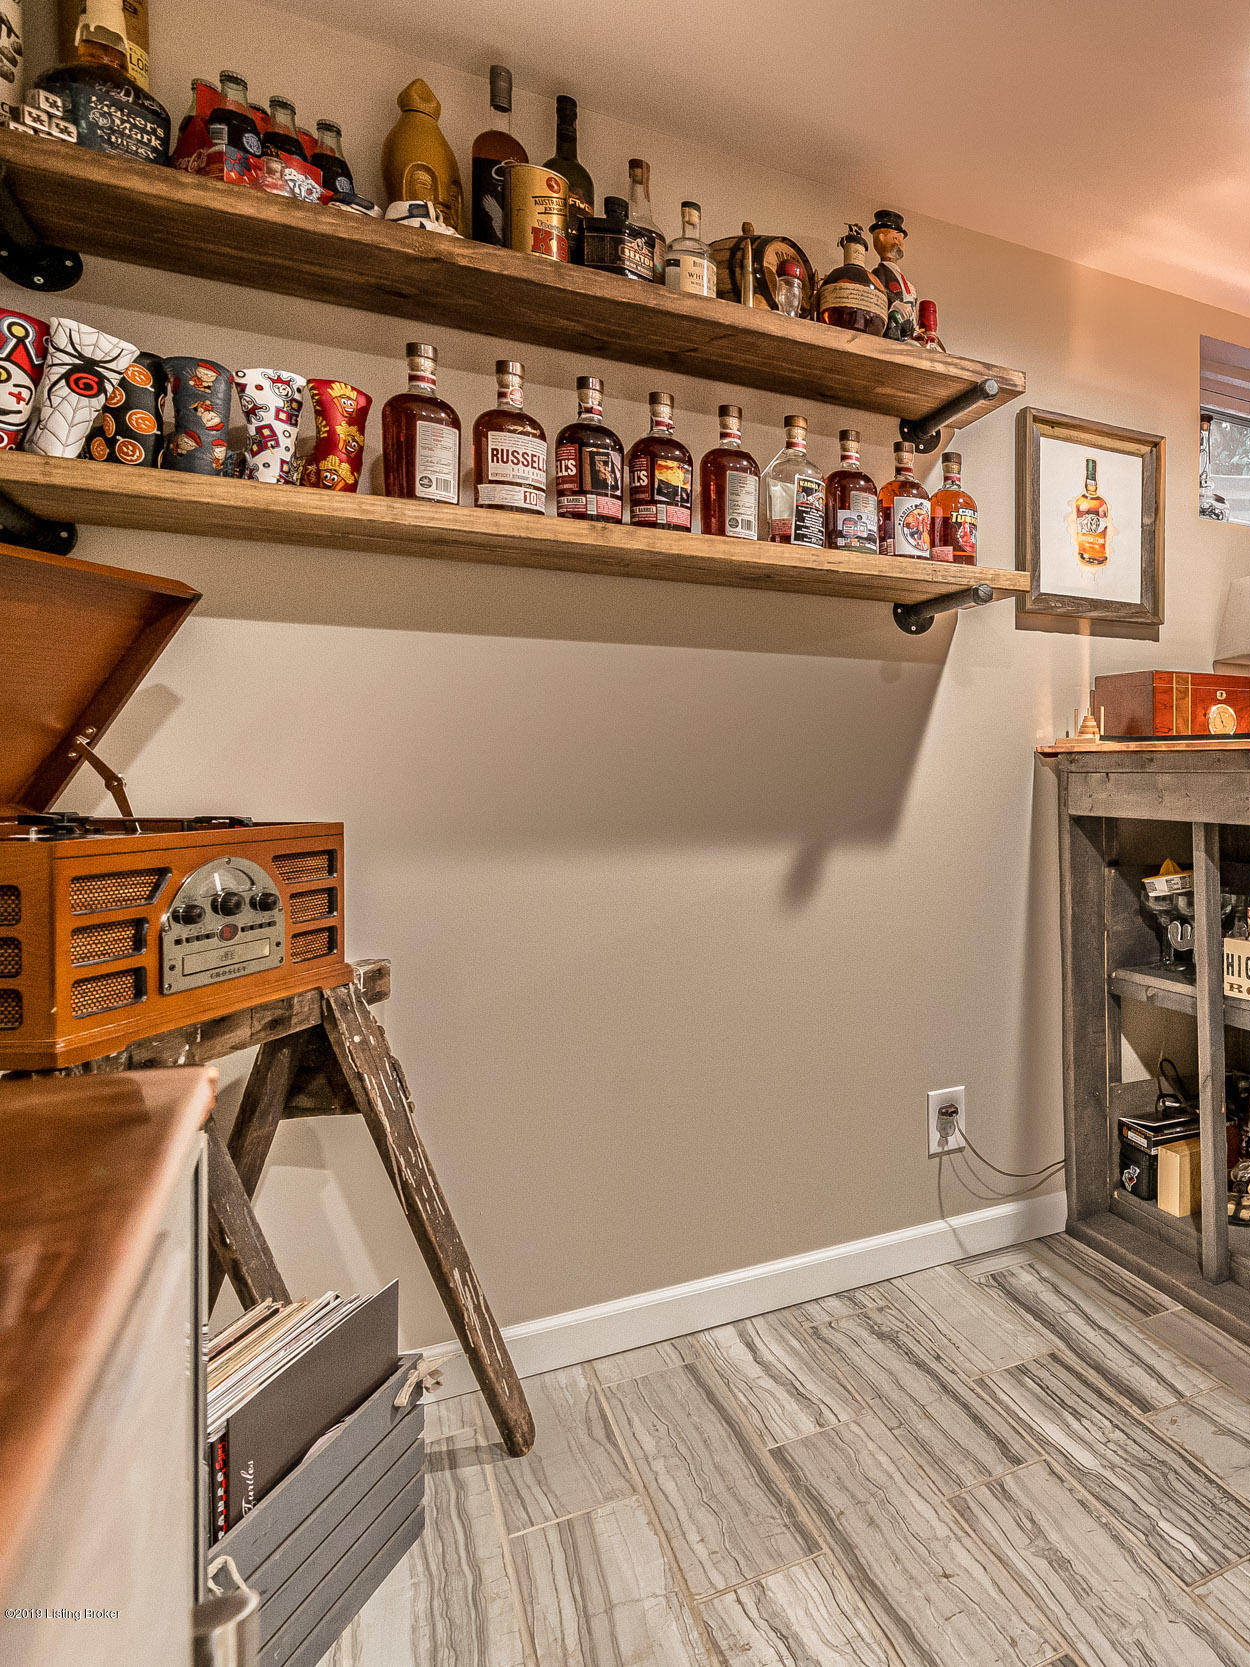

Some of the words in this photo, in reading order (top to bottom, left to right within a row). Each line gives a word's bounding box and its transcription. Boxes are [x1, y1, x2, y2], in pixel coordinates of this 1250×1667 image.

[89, 96, 165, 138] Maker's
[113, 114, 163, 151] Mark
[531, 226, 568, 262] KB
[524, 491, 537, 505] 10
[209, 965, 248, 980] CROSLEY
